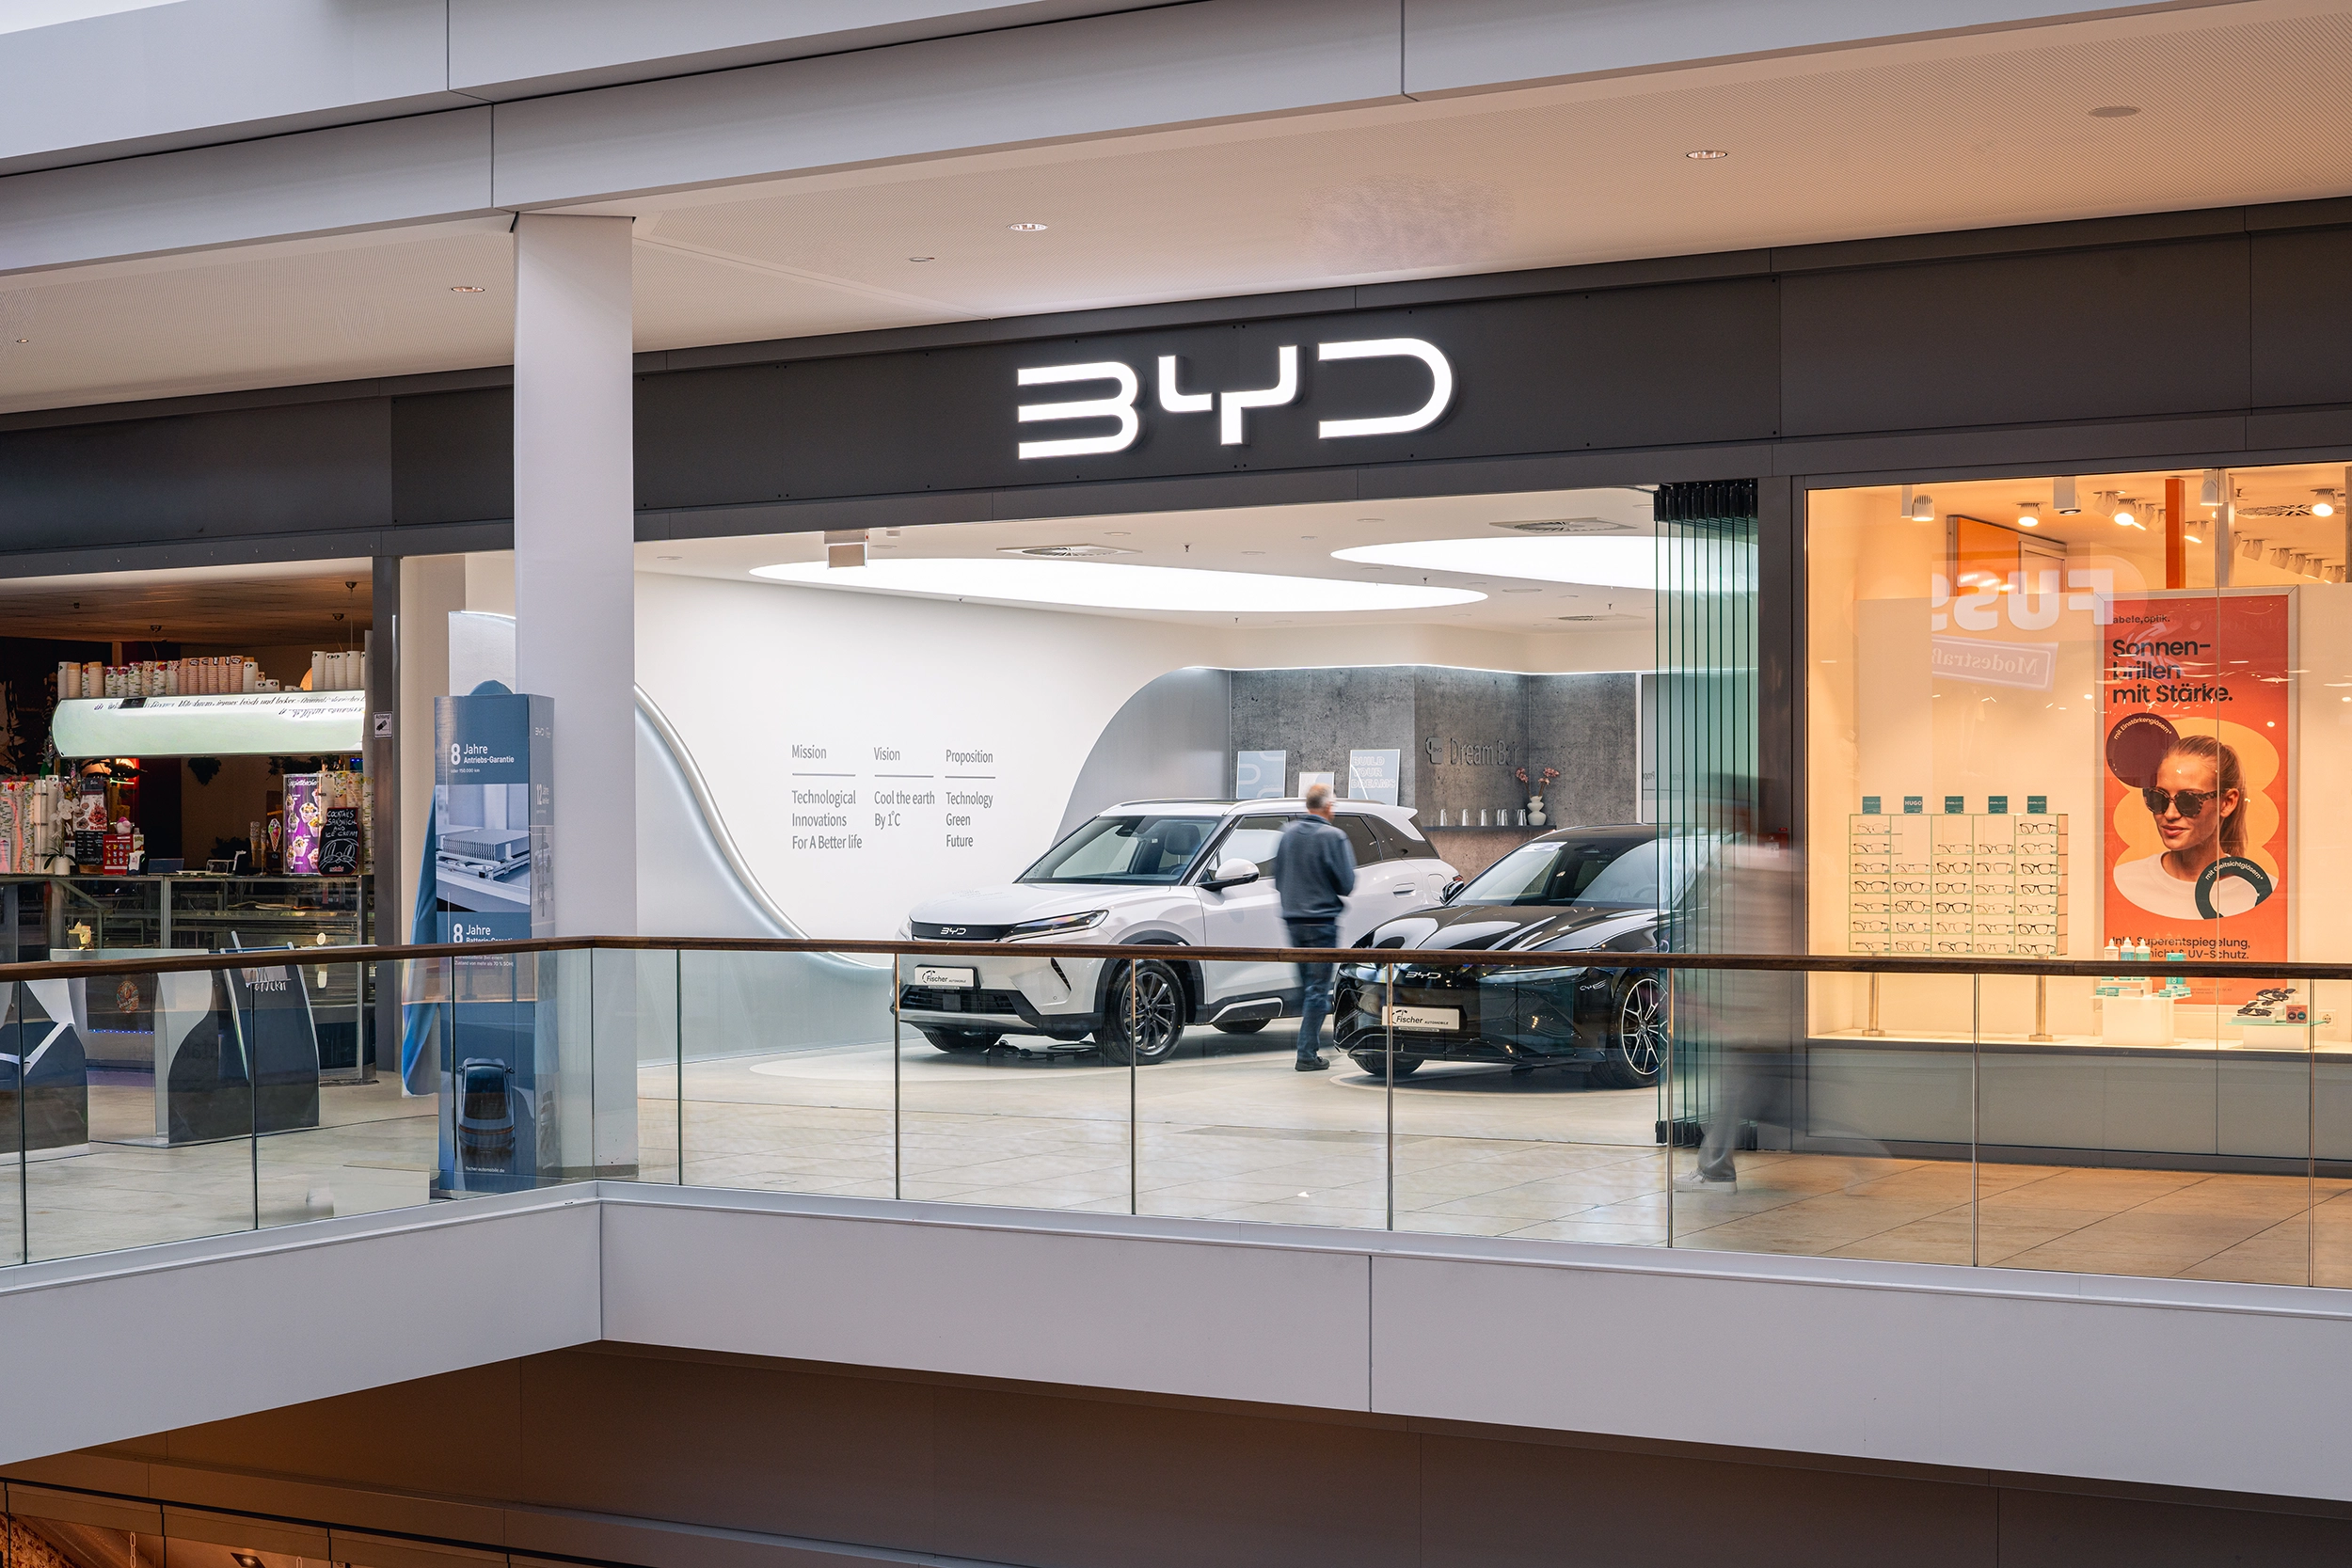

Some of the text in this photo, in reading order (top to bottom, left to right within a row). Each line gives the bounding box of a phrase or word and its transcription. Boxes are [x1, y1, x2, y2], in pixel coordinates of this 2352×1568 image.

[1017, 337, 1453, 460] BYD
[2113, 615, 2170, 624] abele,optik.
[2113, 639, 2211, 657] Sonnen-
[2113, 660, 2181, 680] brillen
[2113, 683, 2233, 704] mit Stärke.
[2114, 729, 2122, 740] mit
[451, 743, 461, 765] 8
[463, 744, 488, 754] Jahre
[792, 744, 826, 759] Mission
[874, 747, 900, 761] Vision
[1450, 738, 1494, 765] Dream
[946, 749, 993, 765] Proposition
[1352, 756, 1385, 766] BUILD
[1352, 767, 1383, 777] YOUR
[1351, 778, 1396, 788] DREAMS
[792, 790, 856, 808] Technological
[874, 790, 935, 805] Cool the earth
[946, 791, 993, 808] Technology
[792, 812, 847, 827] Innovations
[874, 813, 886, 830] By
[946, 813, 971, 826] Green
[792, 834, 862, 849] For A Better life
[946, 834, 973, 847] Future
[2205, 861, 2263, 880] mit Geitsichtgläsern
[453, 923, 463, 943] 8
[466, 924, 491, 935] Jahre
[2137, 937, 2250, 950] Superentspiegelung,
[2188, 950, 2249, 959] UV-Schutz.
